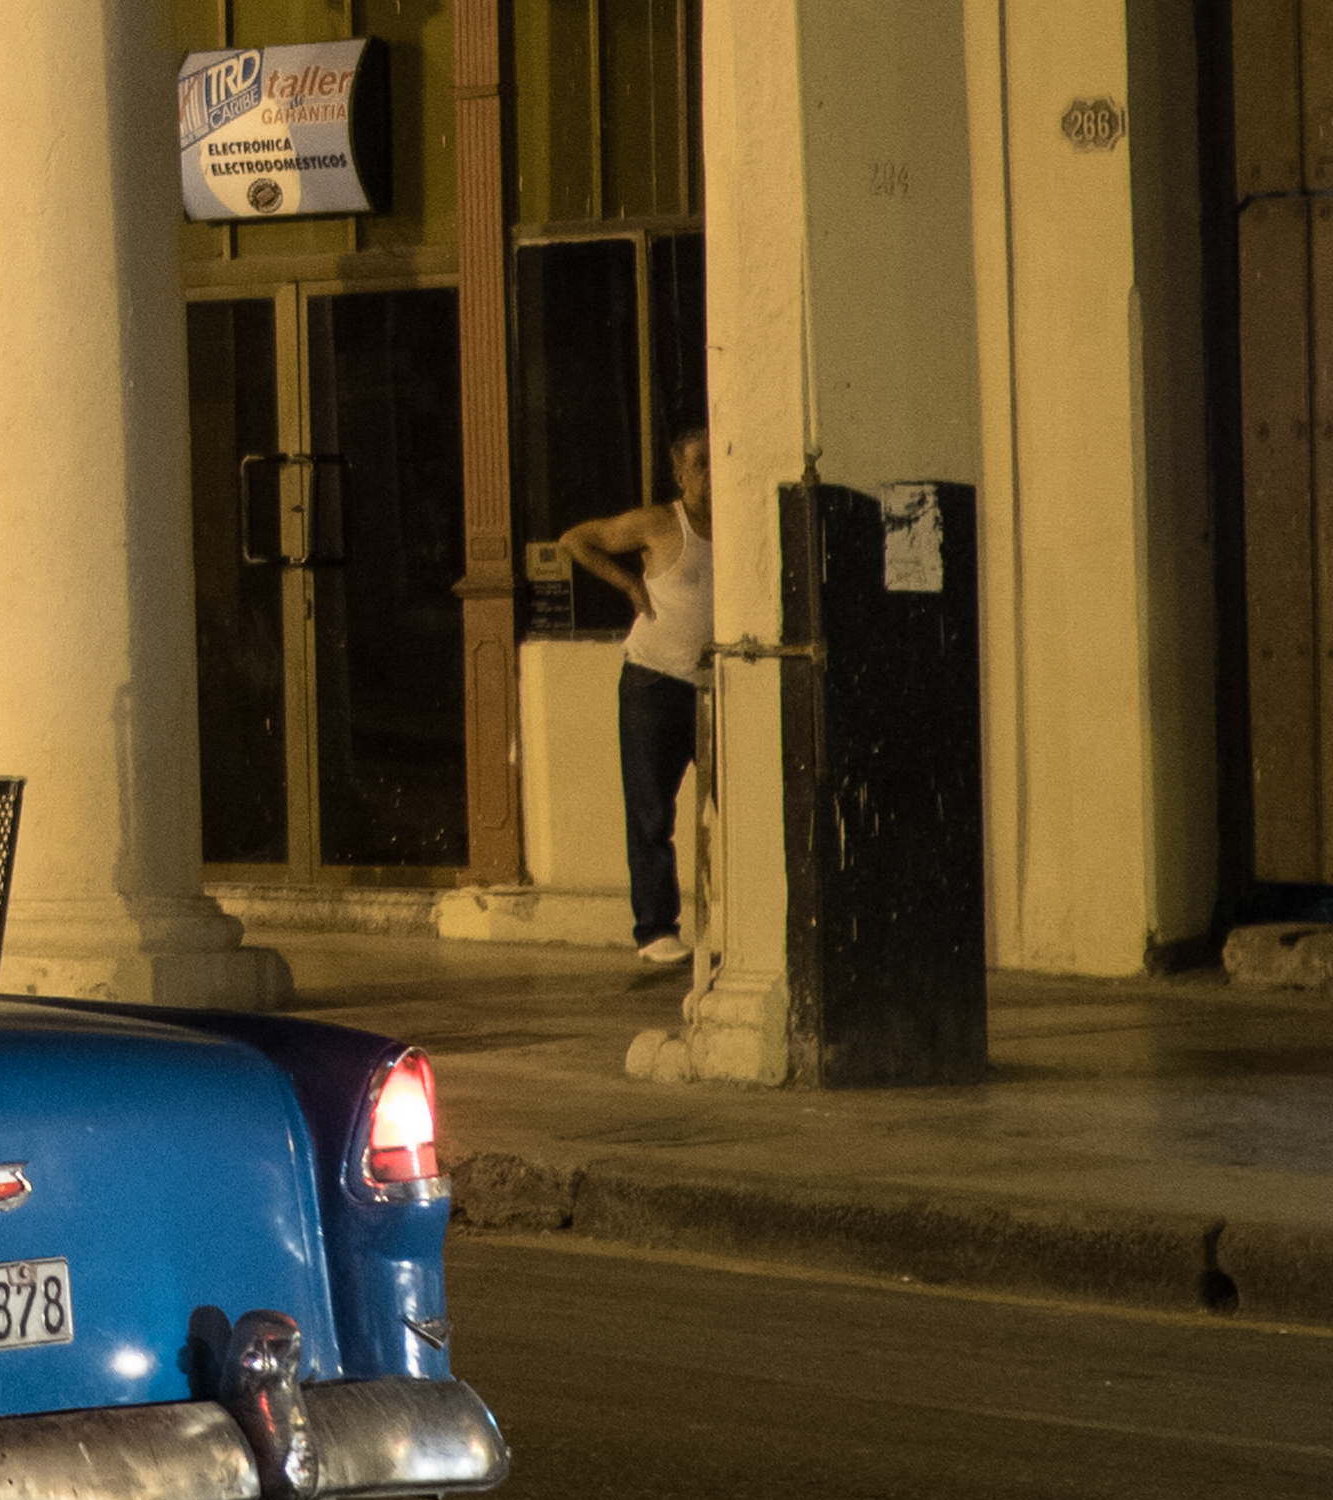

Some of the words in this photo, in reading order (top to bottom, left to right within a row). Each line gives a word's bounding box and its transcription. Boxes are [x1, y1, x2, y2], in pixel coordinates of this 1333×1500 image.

[207, 50, 261, 105] TRD
[268, 65, 354, 99] taller
[210, 86, 259, 128] CARIBE
[1072, 110, 1110, 140] 266
